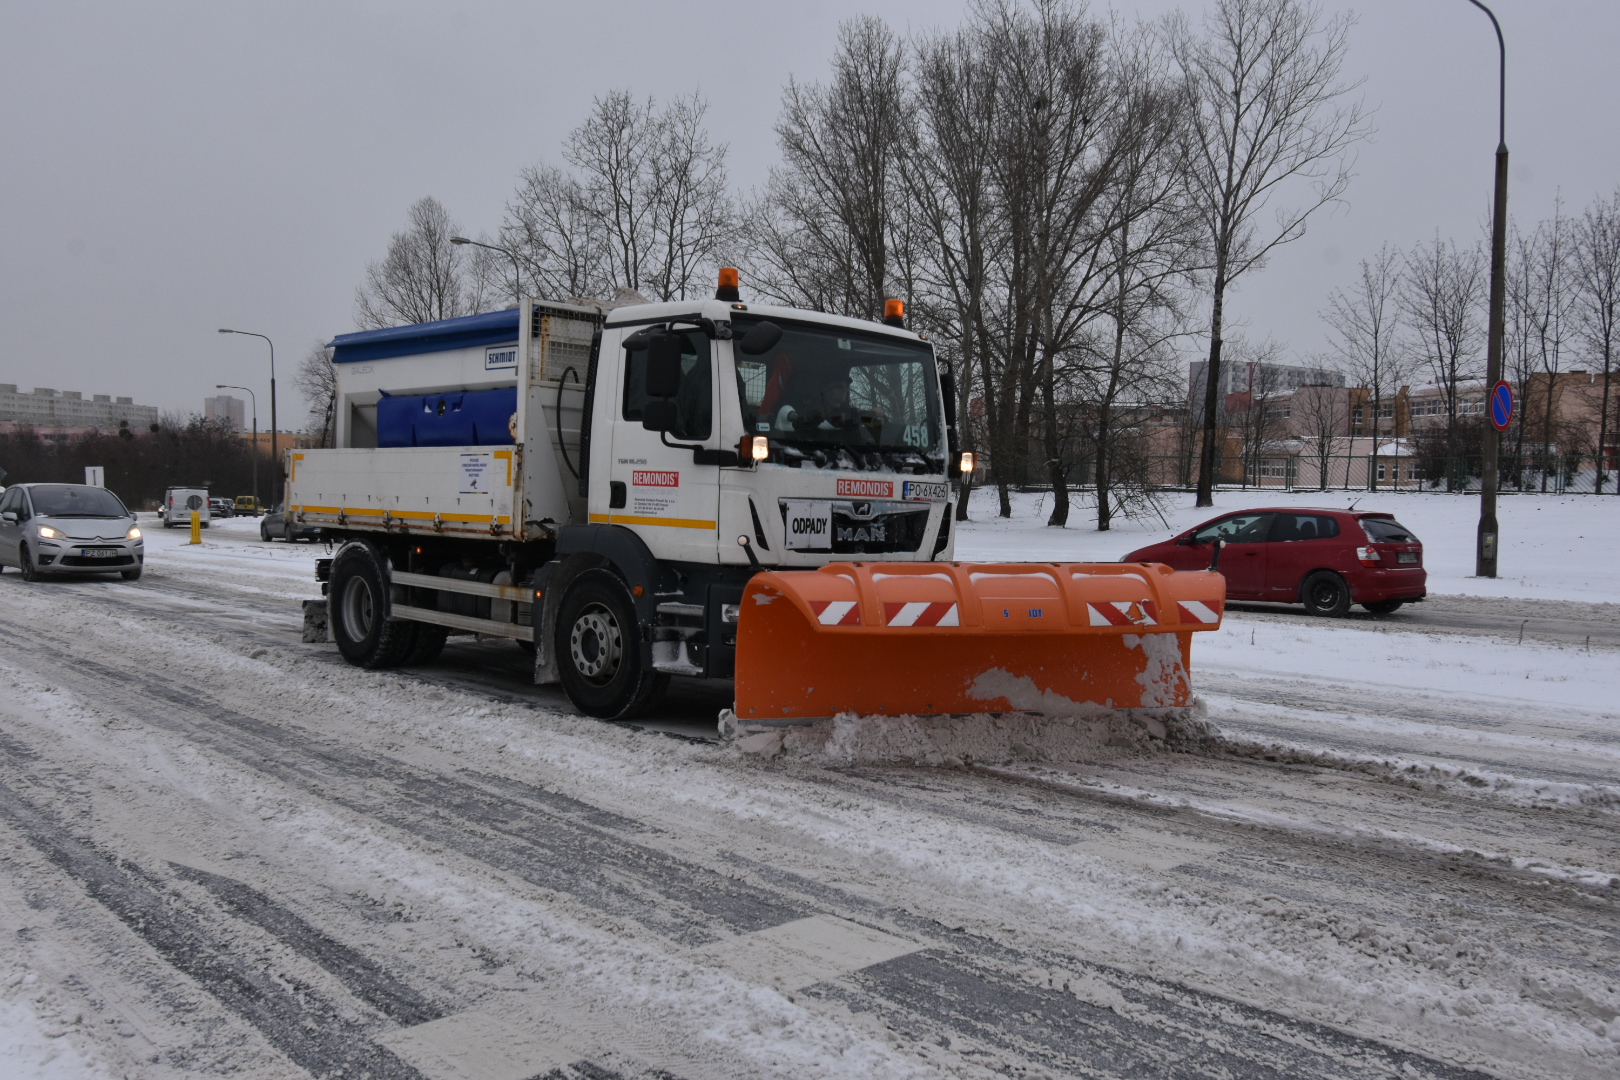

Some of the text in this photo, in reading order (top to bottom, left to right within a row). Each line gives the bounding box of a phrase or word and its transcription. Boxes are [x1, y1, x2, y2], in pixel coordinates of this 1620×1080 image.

[488, 350, 516, 364] SCHMIDT
[903, 424, 929, 448] 458
[633, 472, 675, 486] REMONDIS
[837, 480, 889, 496] REMONDIS
[909, 483, 921, 497] PO
[792, 518, 828, 535] ODPADY
[837, 526, 886, 542] MAN
